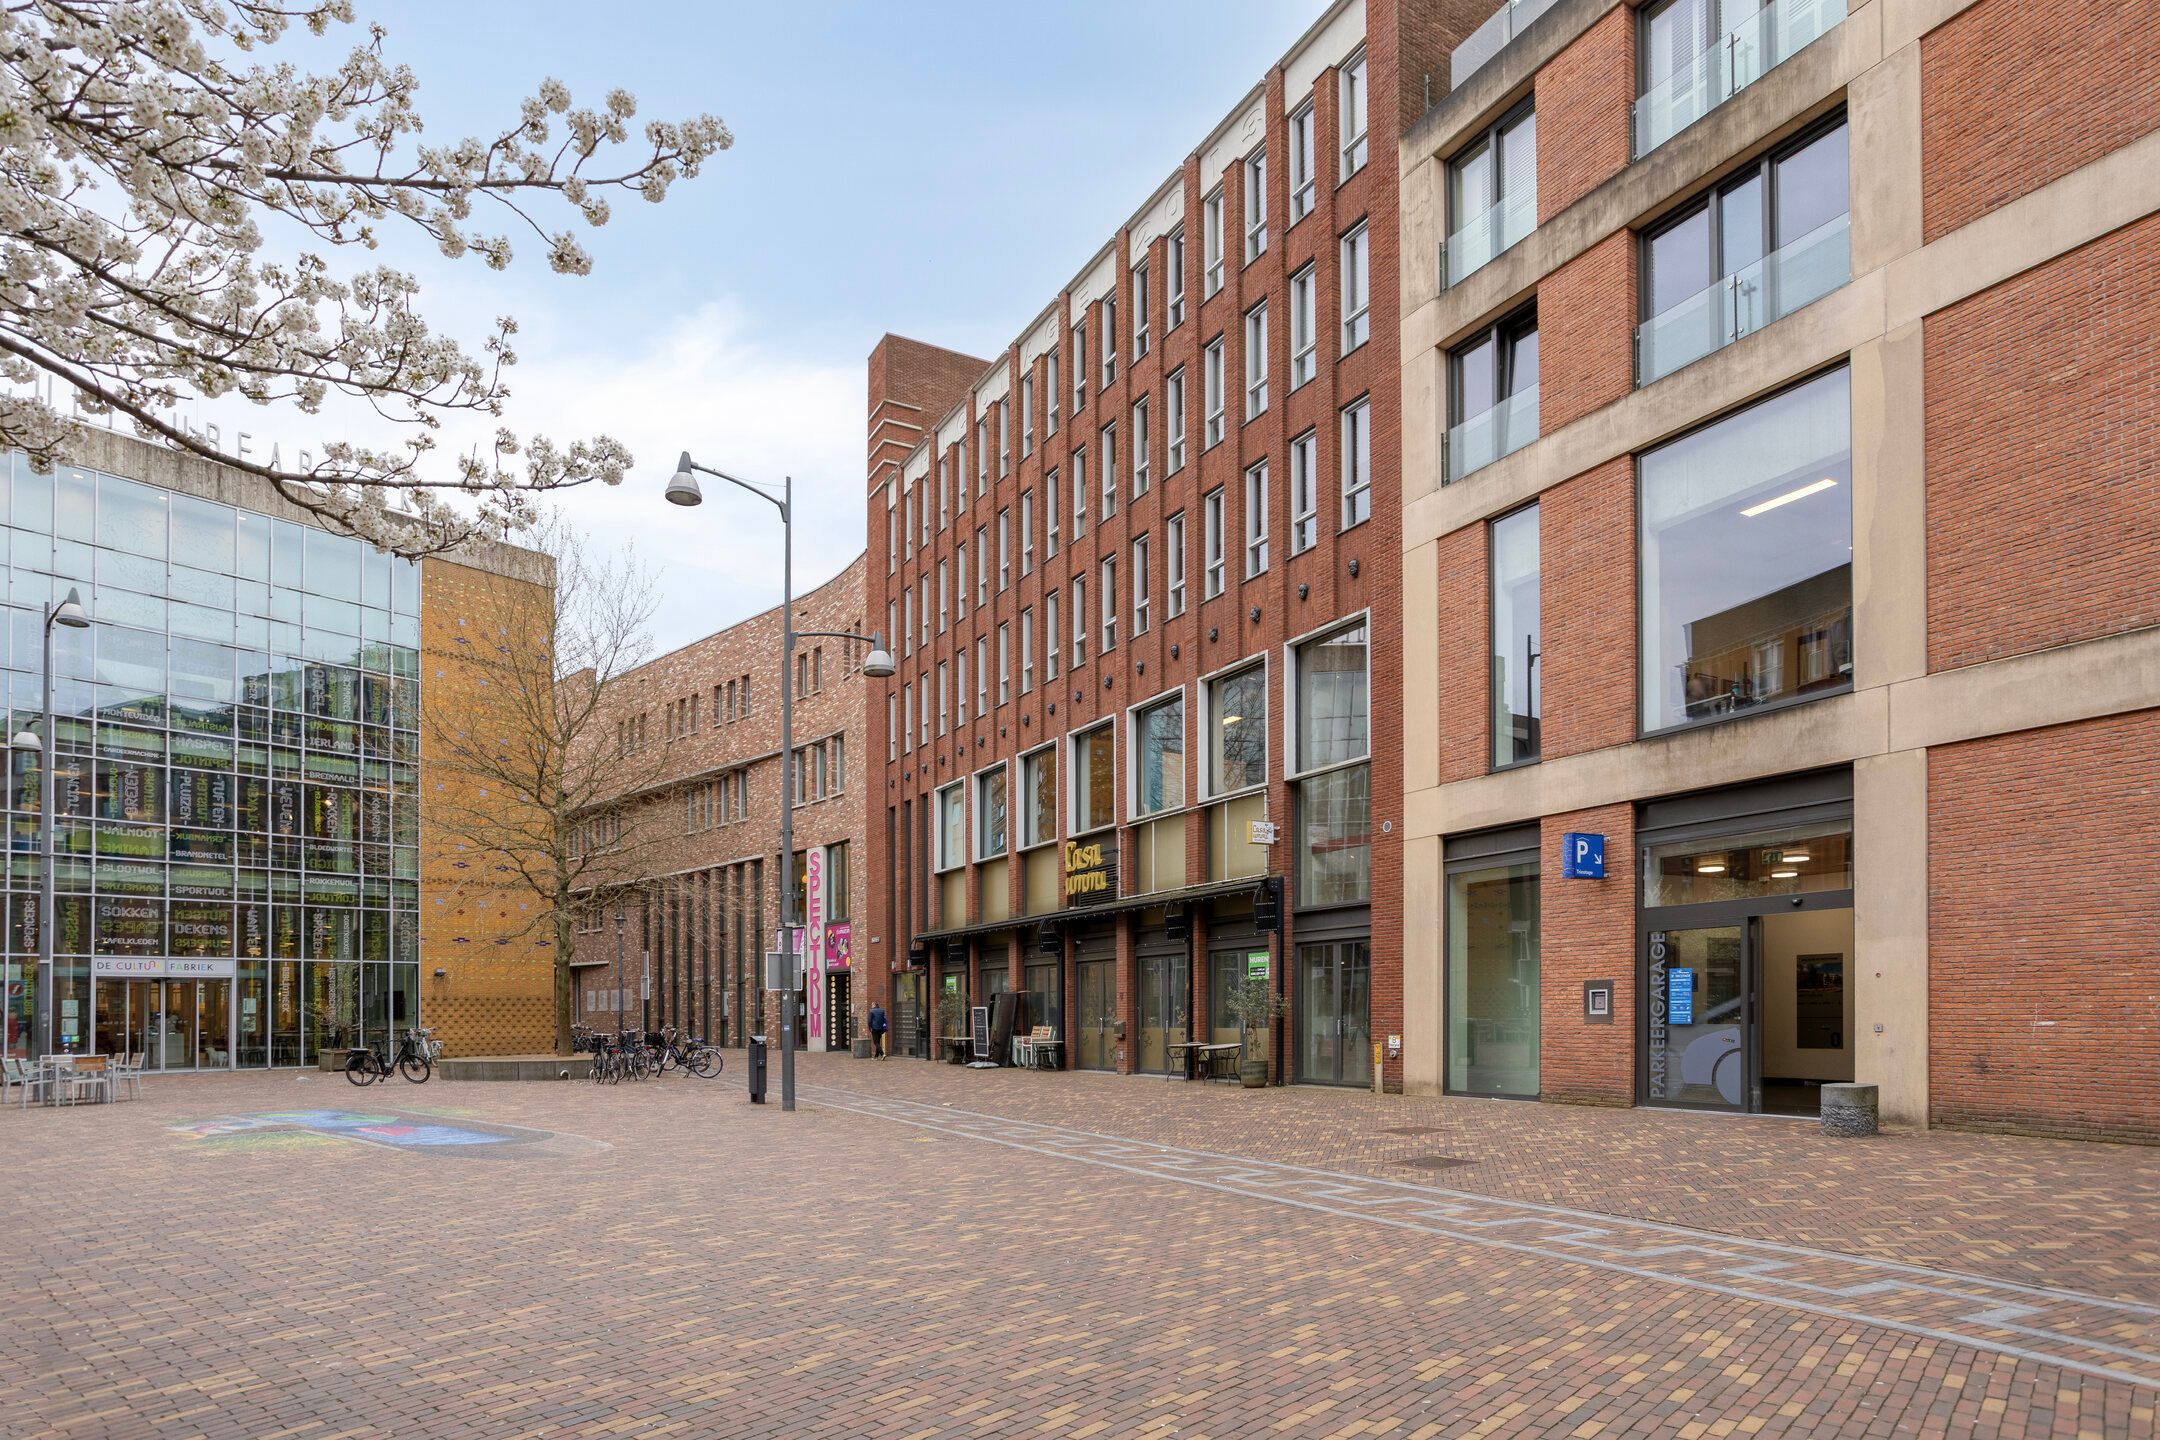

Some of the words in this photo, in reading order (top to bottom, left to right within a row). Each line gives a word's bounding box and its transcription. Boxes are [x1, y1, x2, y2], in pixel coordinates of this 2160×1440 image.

[309, 737, 355, 751] IERLAND
[125, 769, 138, 816] BREIEN
[180, 776, 191, 820] PLUIZEN
[213, 781, 225, 823] TUFTEN
[327, 793, 338, 833] REKKEN
[175, 850, 227, 860] BRANDNETEL
[1065, 841, 1103, 872] Casa
[1577, 841, 1588, 864] P
[175, 886, 228, 896] SPORTWOL
[24, 900, 36, 948] SPENCERS
[101, 906, 159, 919] SOKKEN
[175, 924, 228, 936] DEKENS
[101, 937, 159, 946] TAFELKLEDEN
[313, 914, 323, 955] SPREIEN
[810, 852, 822, 1038] SPECTRUM
[97, 962, 111, 970] DE
[170, 963, 213, 971] FABRIEK
[282, 967, 290, 1013] BIBLIOTHEEK
[1651, 931, 1666, 1098] PARKEERGARAGE
